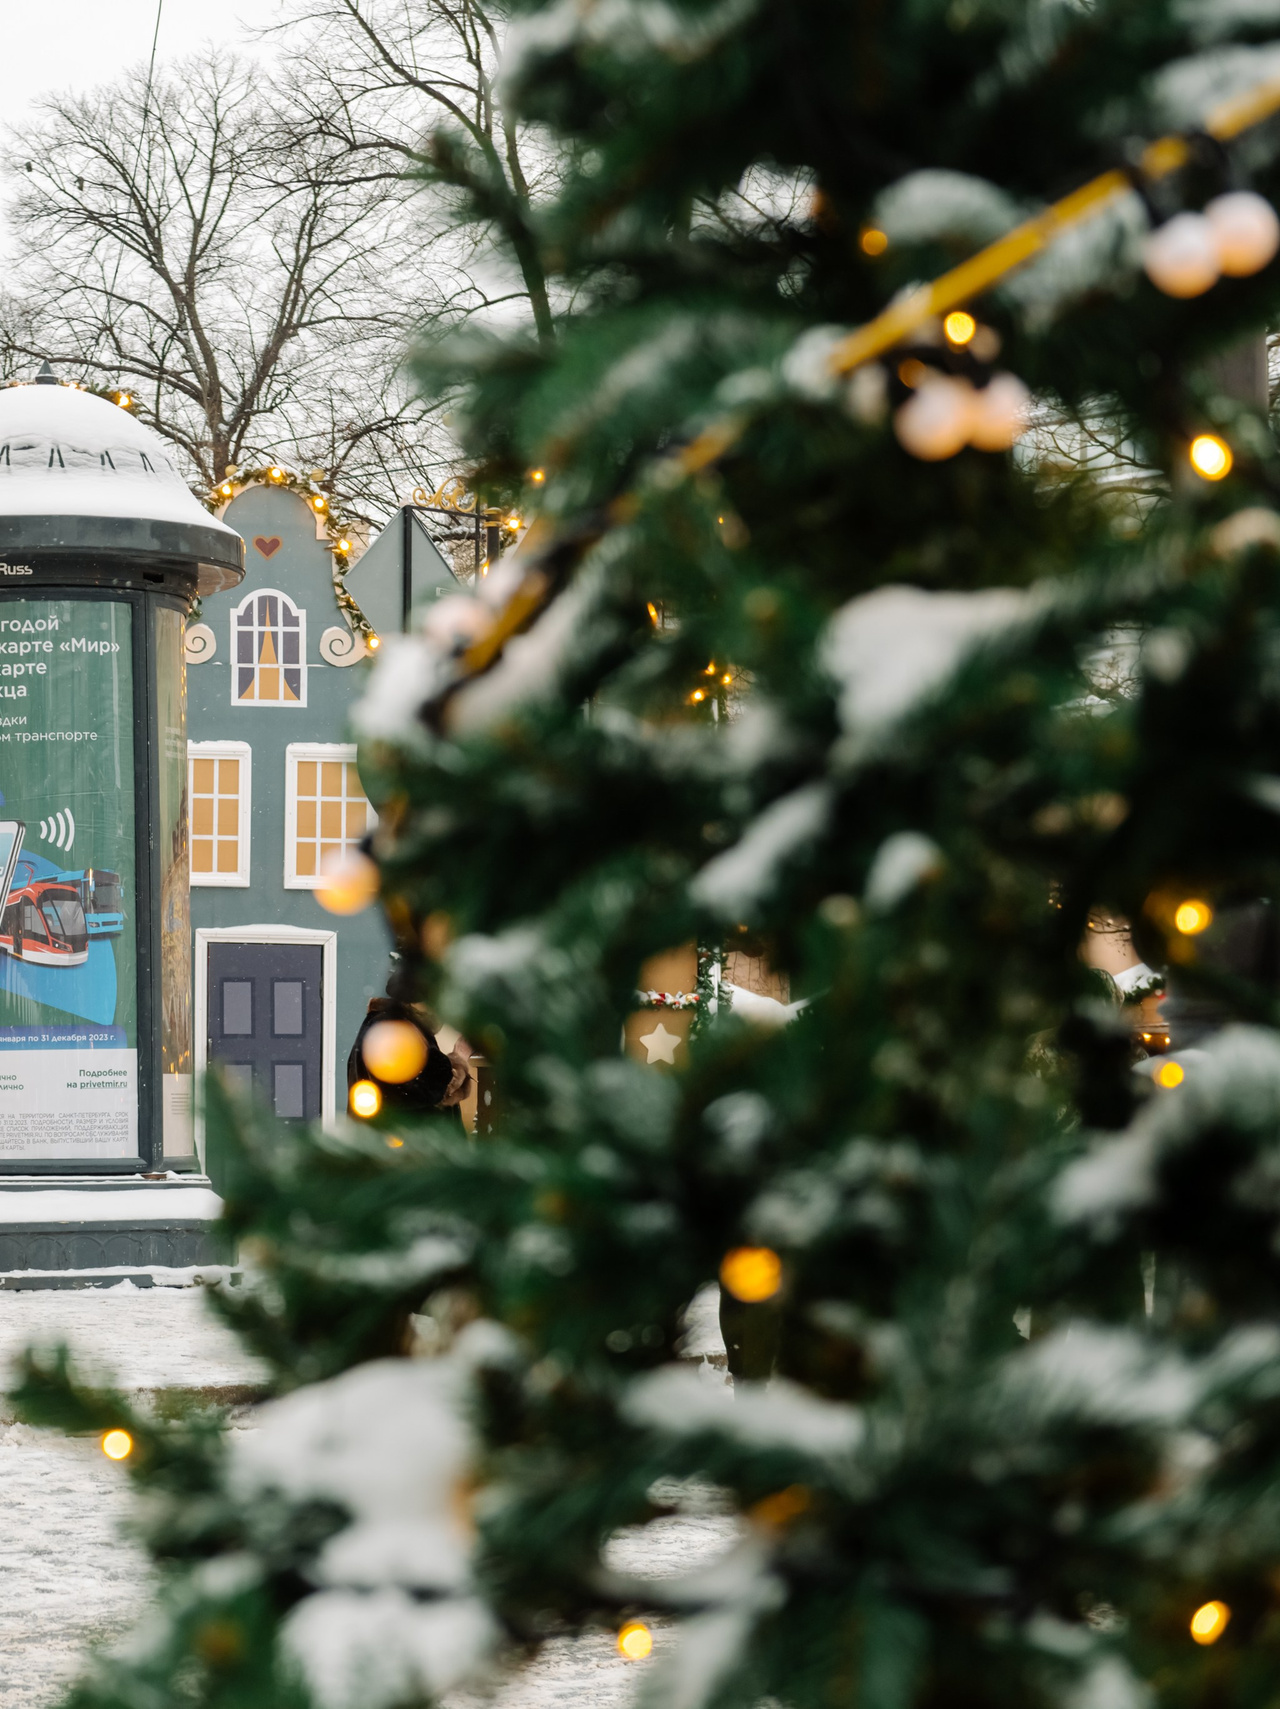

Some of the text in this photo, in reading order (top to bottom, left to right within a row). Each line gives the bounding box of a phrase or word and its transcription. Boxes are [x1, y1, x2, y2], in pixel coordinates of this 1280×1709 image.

[60, 637, 120, 656] «Мир»
[15, 731, 99, 744] транспорте
[41, 1034, 50, 1042] 31
[51, 1034, 87, 1043] декабря
[79, 1069, 128, 1078] Подробнее
[80, 1080, 128, 1089] privetmir.ru
